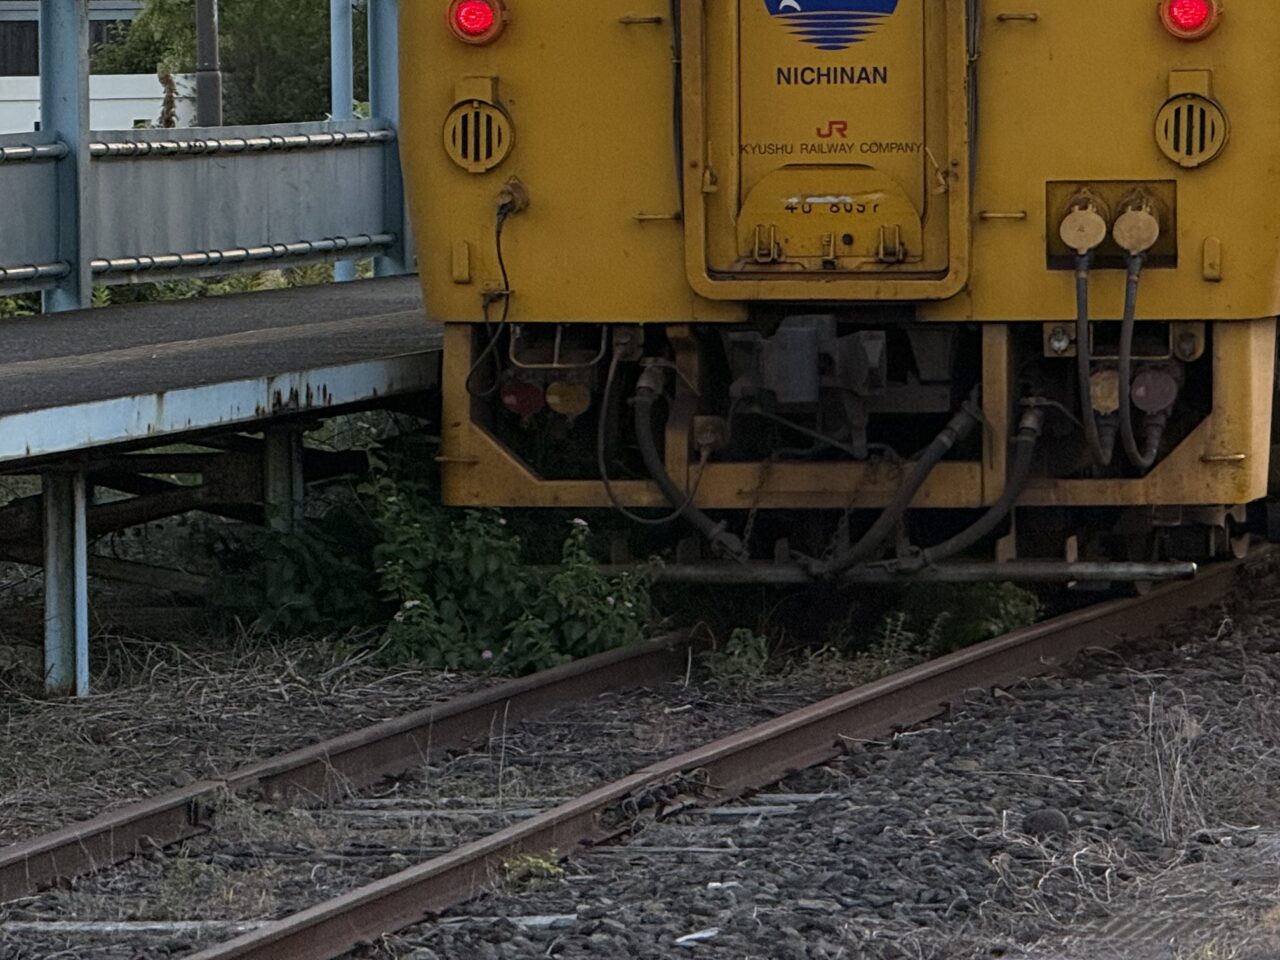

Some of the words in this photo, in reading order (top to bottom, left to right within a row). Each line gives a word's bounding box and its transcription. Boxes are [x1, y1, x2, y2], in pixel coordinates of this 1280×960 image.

[776, 66, 888, 86] NICHINAN
[816, 120, 847, 138] JR
[740, 143, 794, 156] KYUSHU
[800, 142, 855, 155] RAILWAY
[860, 141, 923, 154] COMPANY
